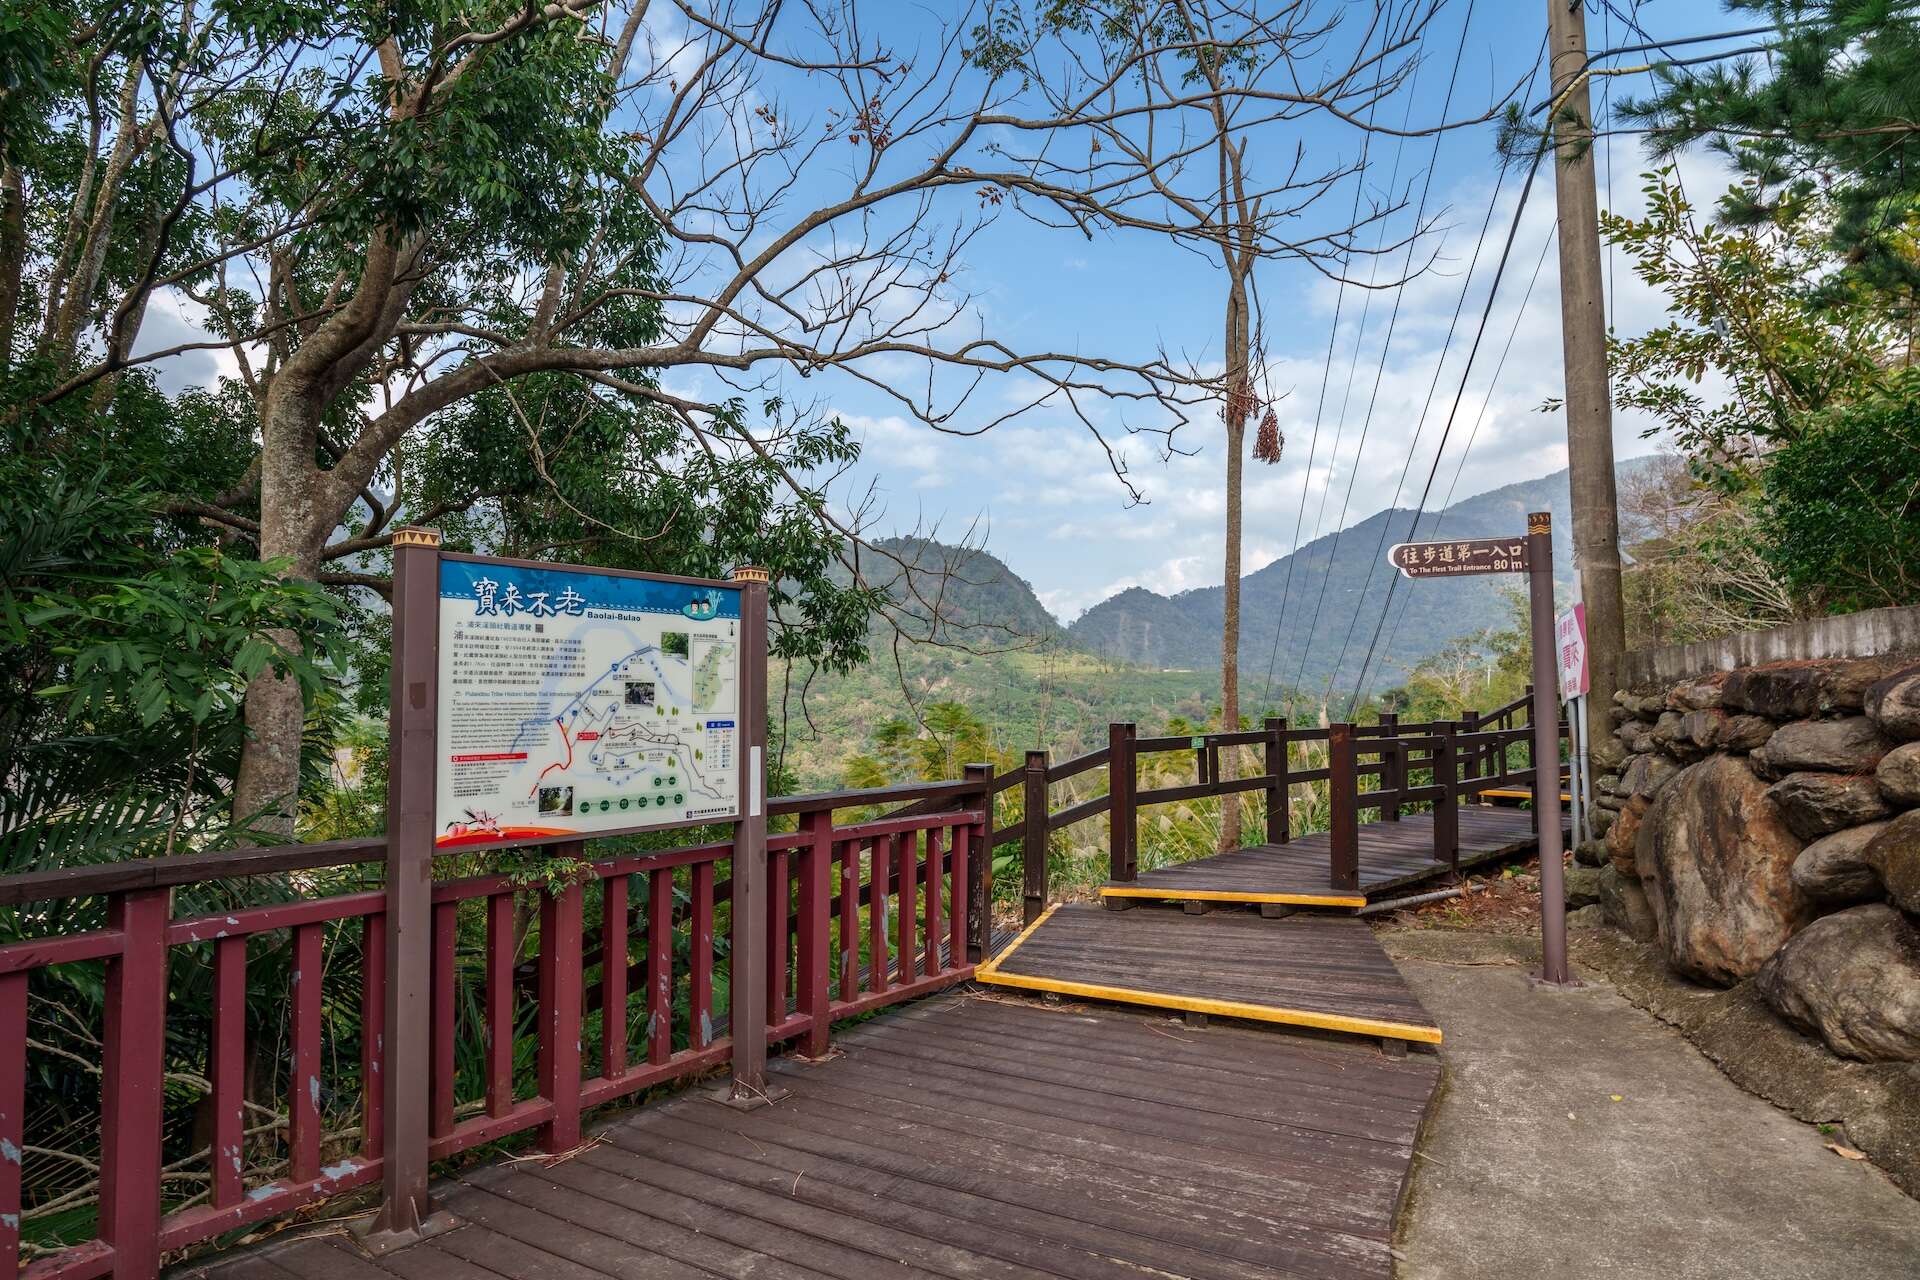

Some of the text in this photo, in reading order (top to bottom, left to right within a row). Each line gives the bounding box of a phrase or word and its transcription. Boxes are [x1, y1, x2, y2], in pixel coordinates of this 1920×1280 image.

[1402, 544, 1522, 564] 往步道第一入口
[1493, 559, 1508, 570] 80
[587, 611, 641, 622] Baolai-Bulao
